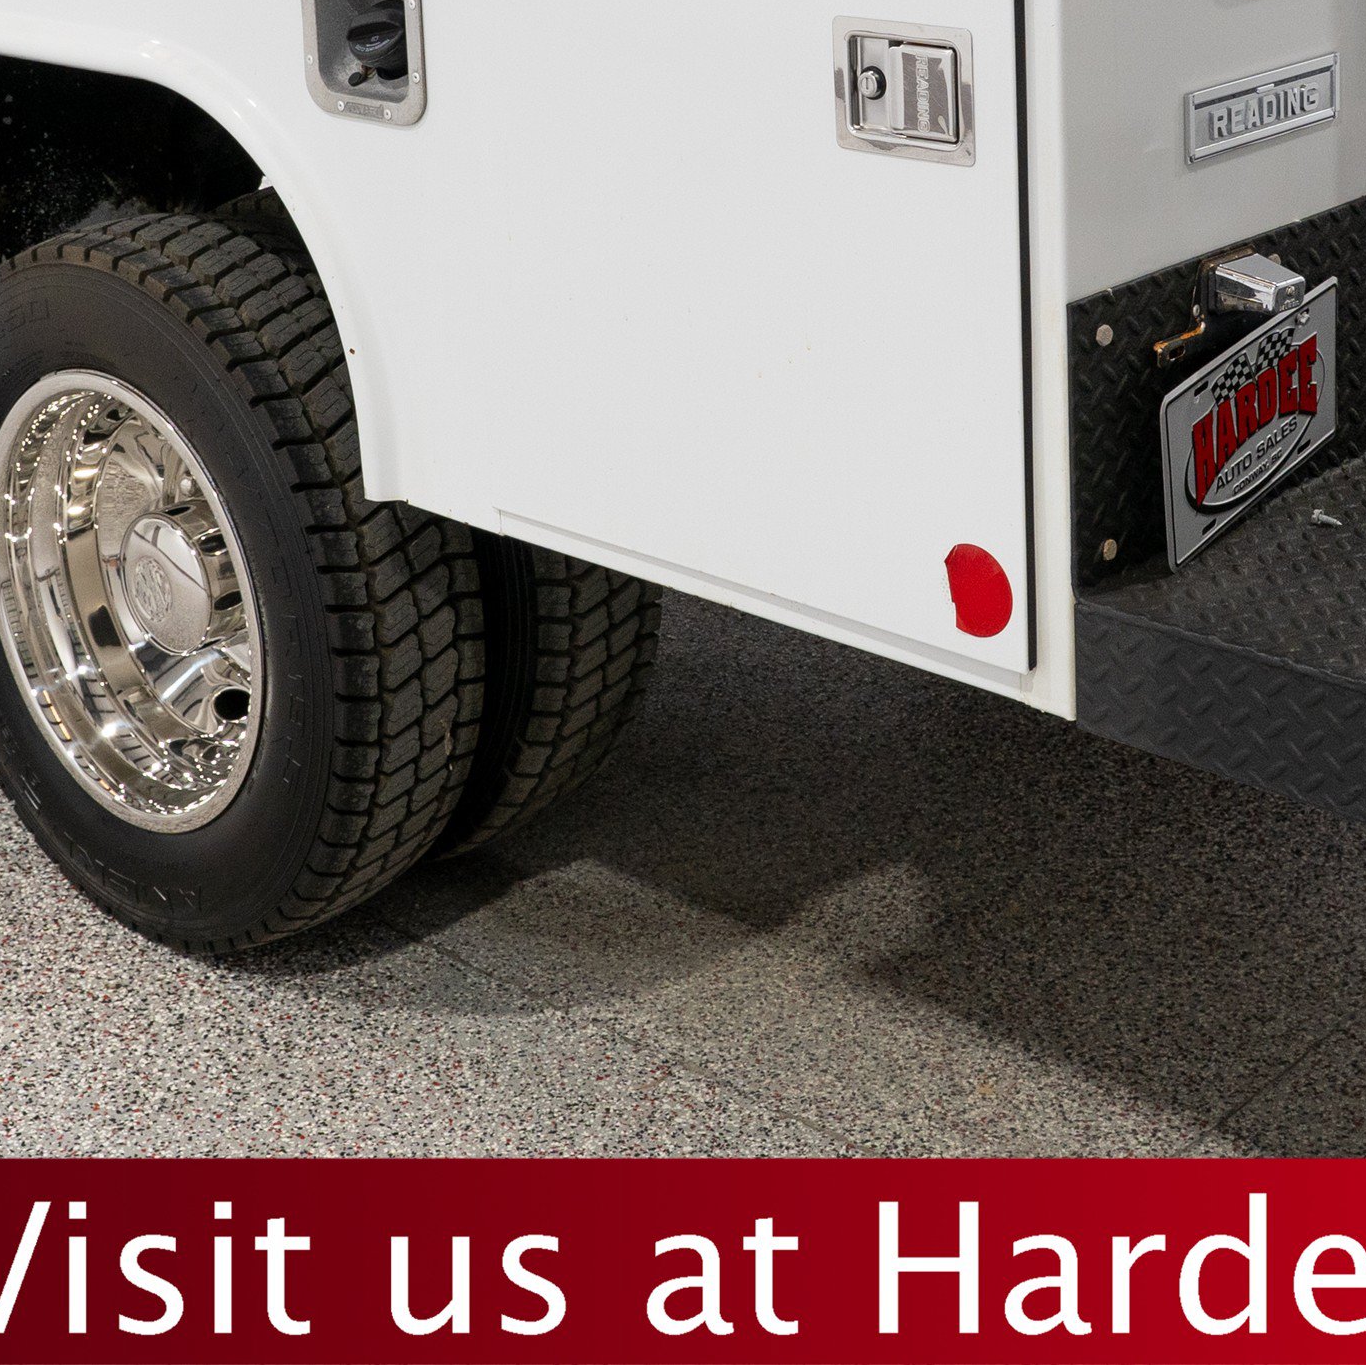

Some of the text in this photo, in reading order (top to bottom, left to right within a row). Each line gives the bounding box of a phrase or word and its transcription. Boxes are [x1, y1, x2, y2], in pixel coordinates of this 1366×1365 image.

[914, 54, 931, 133] READING
[1210, 82, 1320, 139] READING
[1191, 332, 1317, 508] HARDEE
[1215, 416, 1298, 494] AUTO SALES
[1233, 460, 1270, 494] CONWAY,
